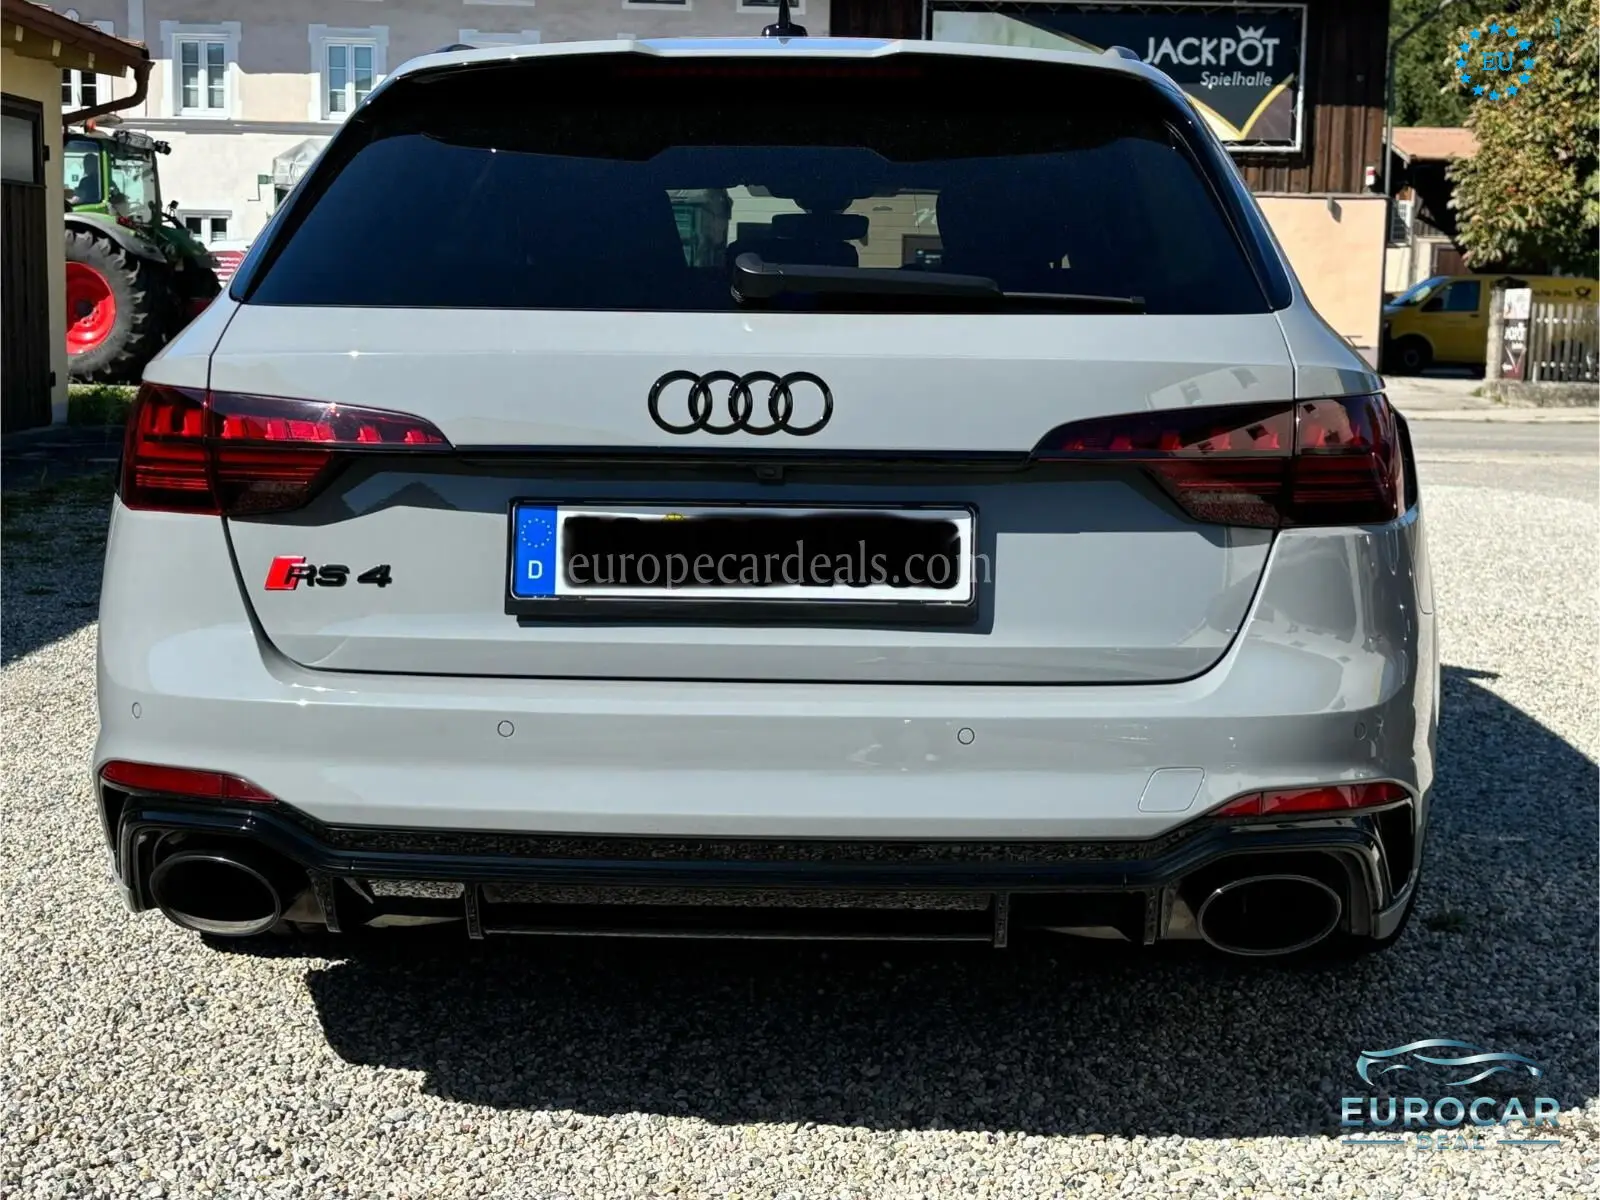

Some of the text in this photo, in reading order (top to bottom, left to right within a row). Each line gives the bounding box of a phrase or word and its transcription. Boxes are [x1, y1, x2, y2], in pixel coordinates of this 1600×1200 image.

[1142, 37, 1280, 67] JACKPOT
[1200, 71, 1273, 90] Spielhalle
[283, 562, 392, 588] RS 4
[527, 560, 543, 579] D
